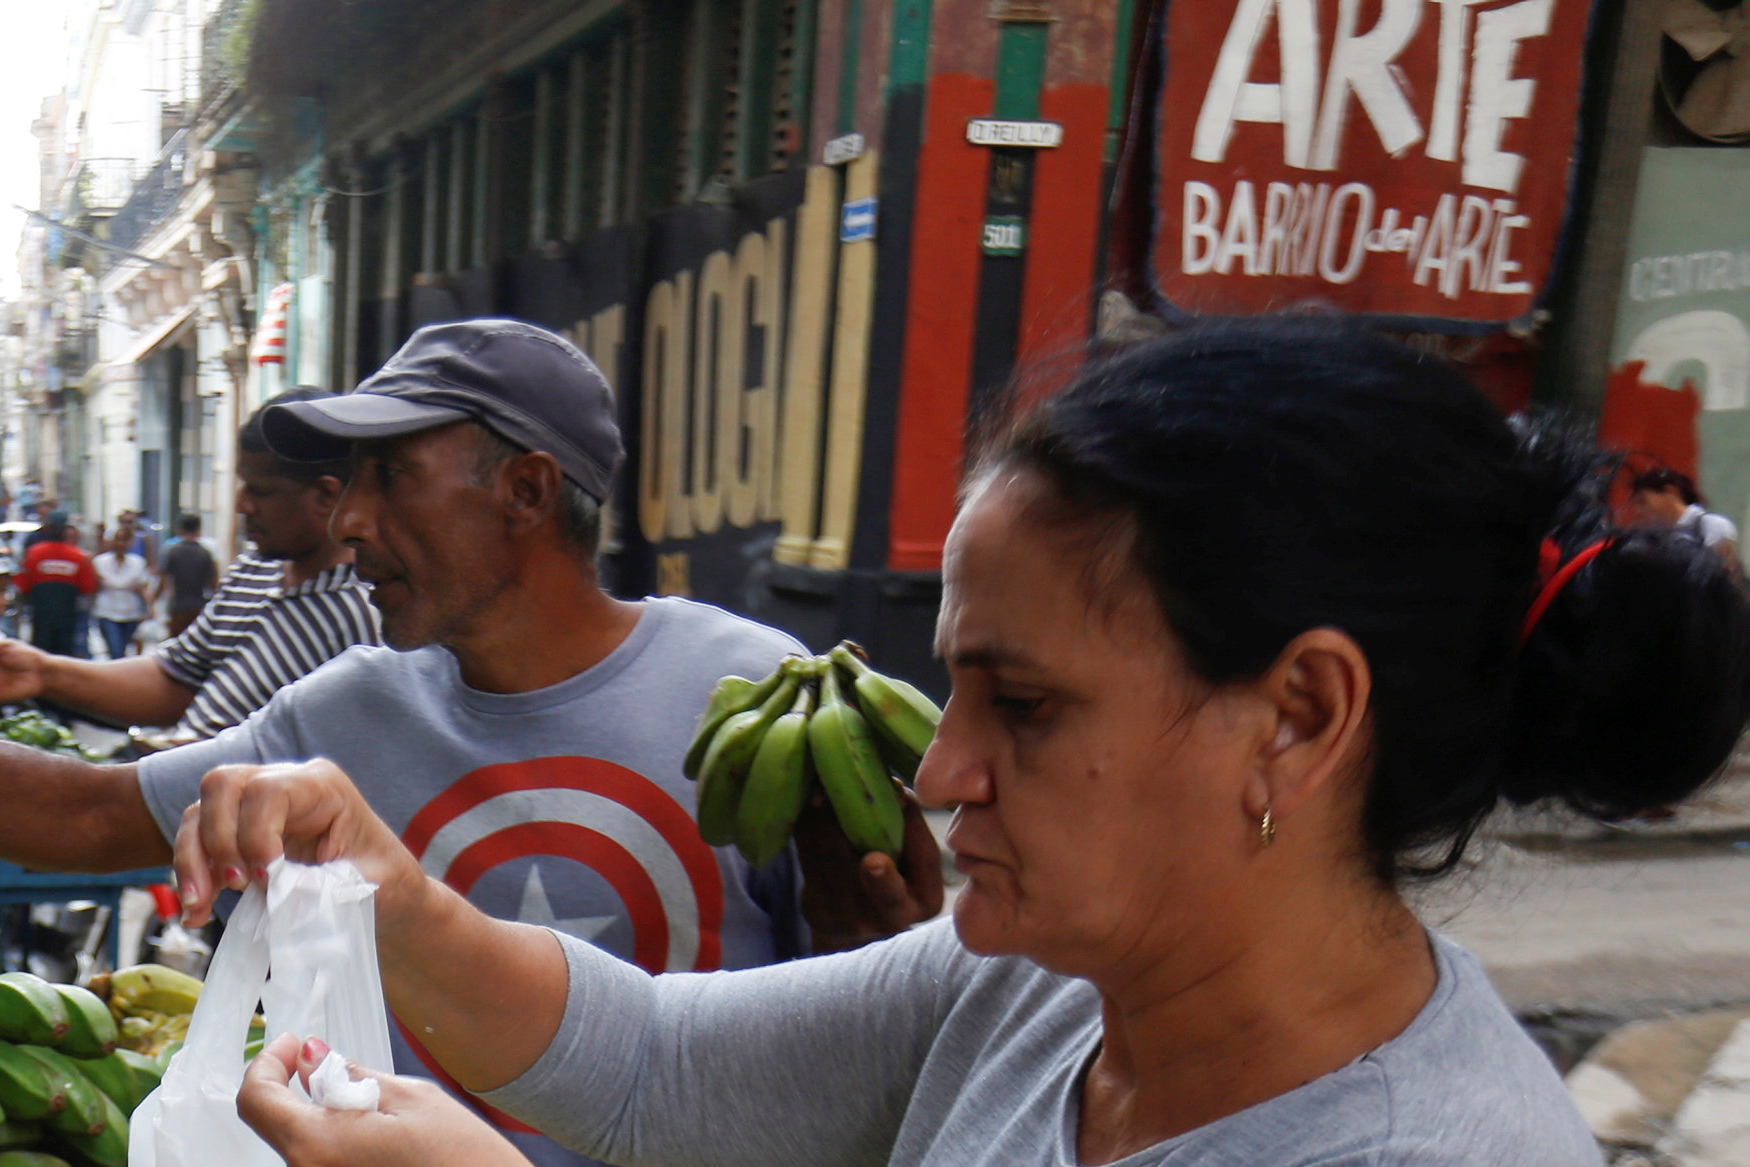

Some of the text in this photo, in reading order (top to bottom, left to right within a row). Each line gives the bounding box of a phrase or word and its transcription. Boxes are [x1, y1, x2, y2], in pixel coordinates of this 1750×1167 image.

[1191, 0, 1550, 192] ARTE
[1182, 180, 1375, 285] BARRIO
[1413, 193, 1532, 299] ARTE
